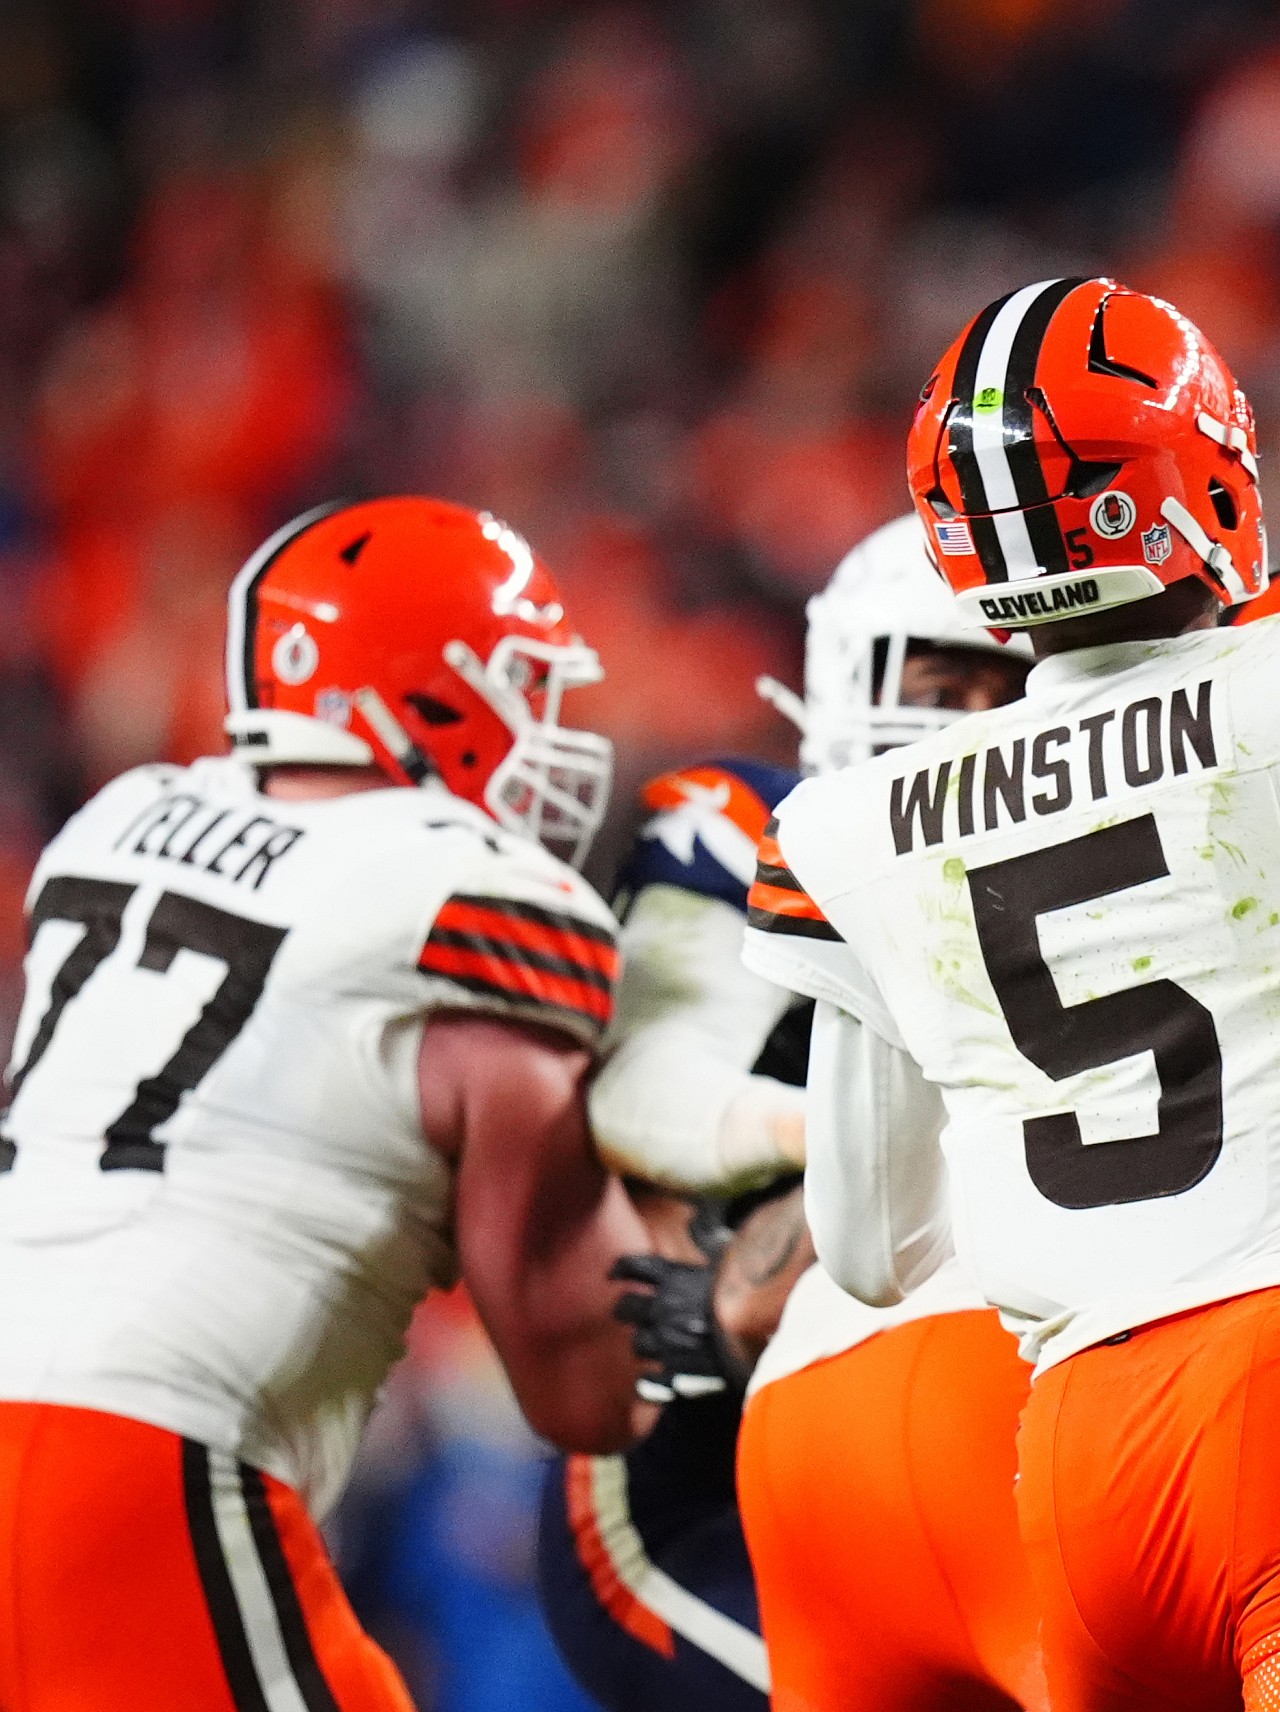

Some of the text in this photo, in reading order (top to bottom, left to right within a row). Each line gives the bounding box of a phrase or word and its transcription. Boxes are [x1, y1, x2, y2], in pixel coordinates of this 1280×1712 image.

[1065, 526, 1095, 570] 5
[1148, 541, 1169, 559] NFL
[978, 579, 1099, 620] CLEVELAND
[889, 679, 1219, 857] WINSTON
[113, 793, 305, 891] TELLER
[0, 875, 292, 1173] 77
[965, 811, 1225, 1211] 5
